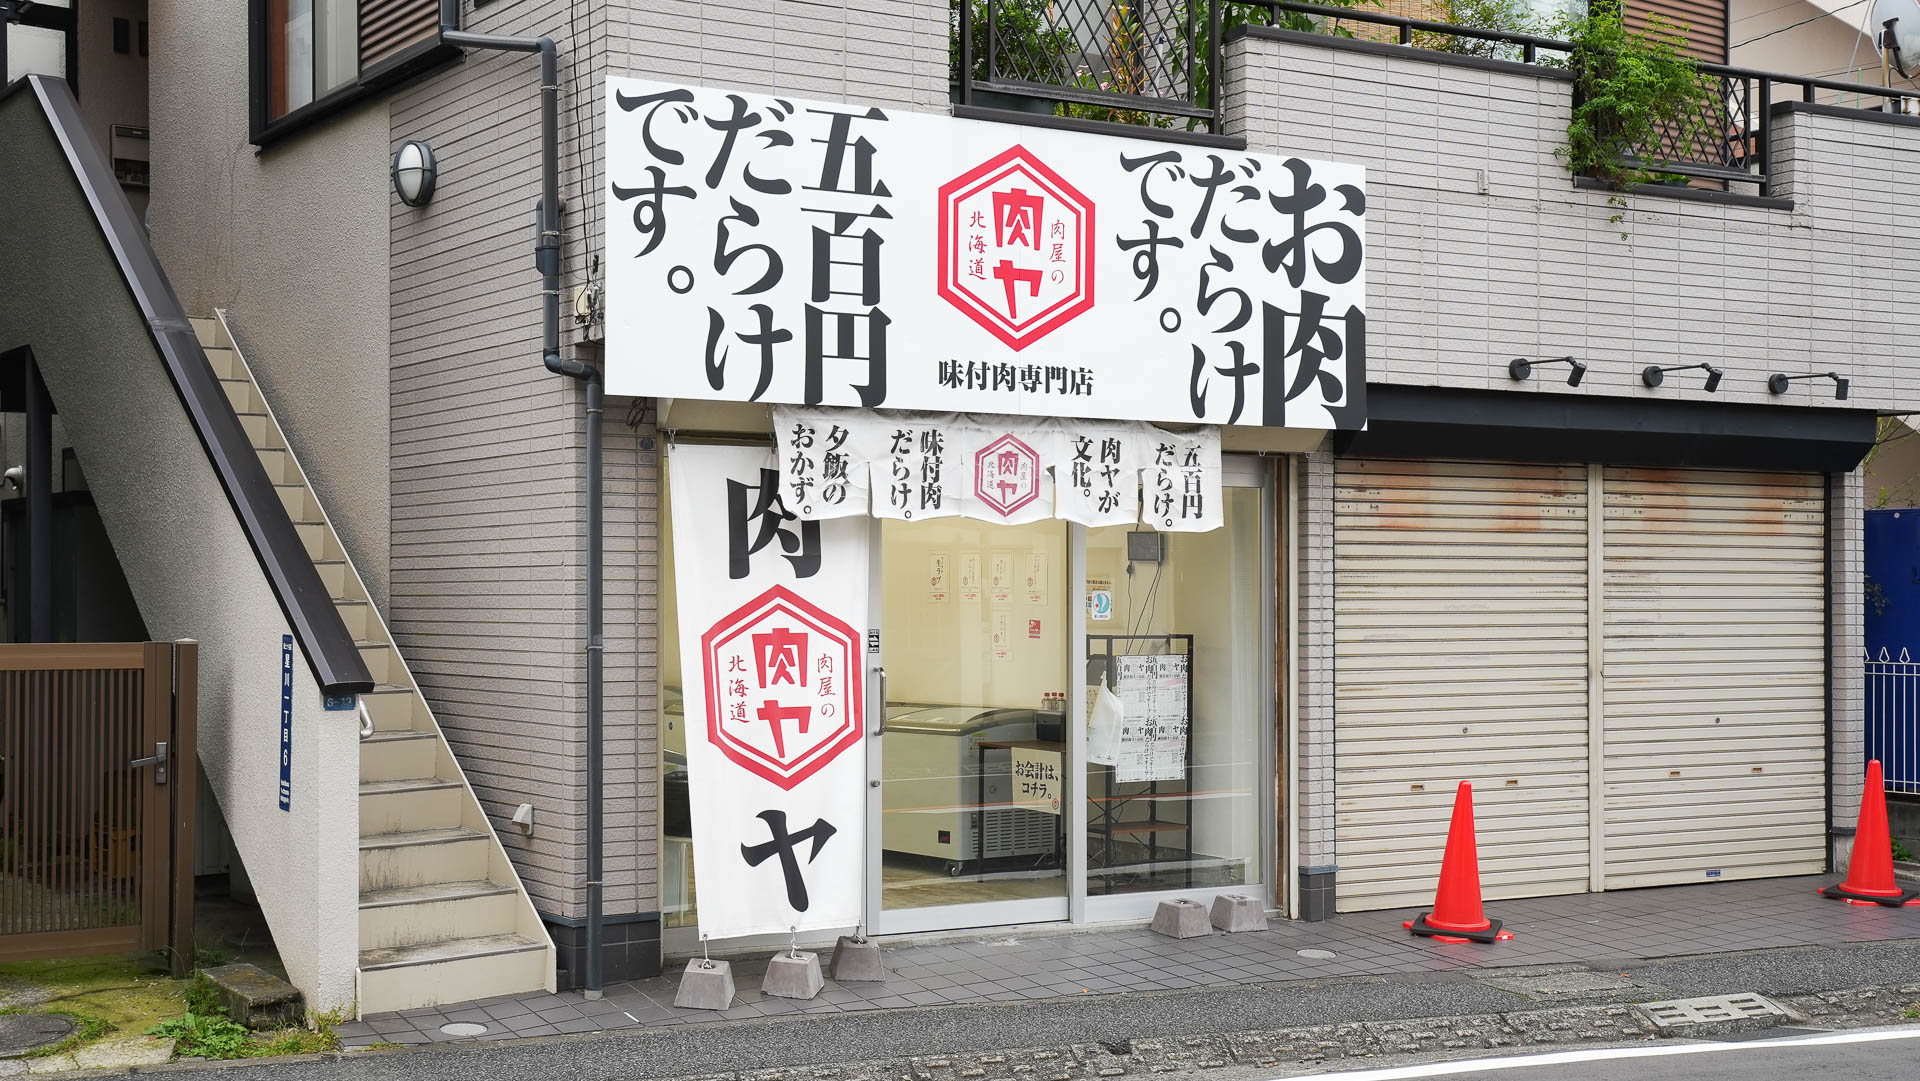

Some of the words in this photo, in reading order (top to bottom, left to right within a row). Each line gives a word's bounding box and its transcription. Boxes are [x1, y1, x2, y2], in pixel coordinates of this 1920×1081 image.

[611, 87, 699, 295] です。
[703, 94, 795, 402] だらけ
[800, 107, 894, 408] 五百円
[968, 210, 988, 281] 北海道
[992, 187, 1045, 319] 肉ヤ
[1050, 218, 1067, 285] 肉屋の
[1116, 150, 1184, 334] です。
[1189, 154, 1261, 425] だらけ
[1261, 157, 1367, 431] お肉
[938, 359, 1095, 397] 味付肉専門店
[789, 423, 816, 515] おかず。
[822, 424, 850, 505] 夕飯の
[890, 429, 913, 519] だらけ。
[920, 429, 944, 510] 味付肉
[997, 450, 1019, 504] 肉ヤ
[1070, 435, 1094, 498] 文化。
[1098, 437, 1121, 514] 肉ヤが
[1154, 442, 1176, 528] だらけ。
[1180, 444, 1203, 520] 五百円
[726, 468, 822, 580] 肉
[728, 654, 750, 724] 北海道
[752, 627, 812, 759] 肉ヤ
[817, 653, 836, 719] 肉屋の
[1015, 760, 1059, 782] お会計は、
[1021, 781, 1052, 800] コチラ。
[740, 809, 838, 914] ヤ
